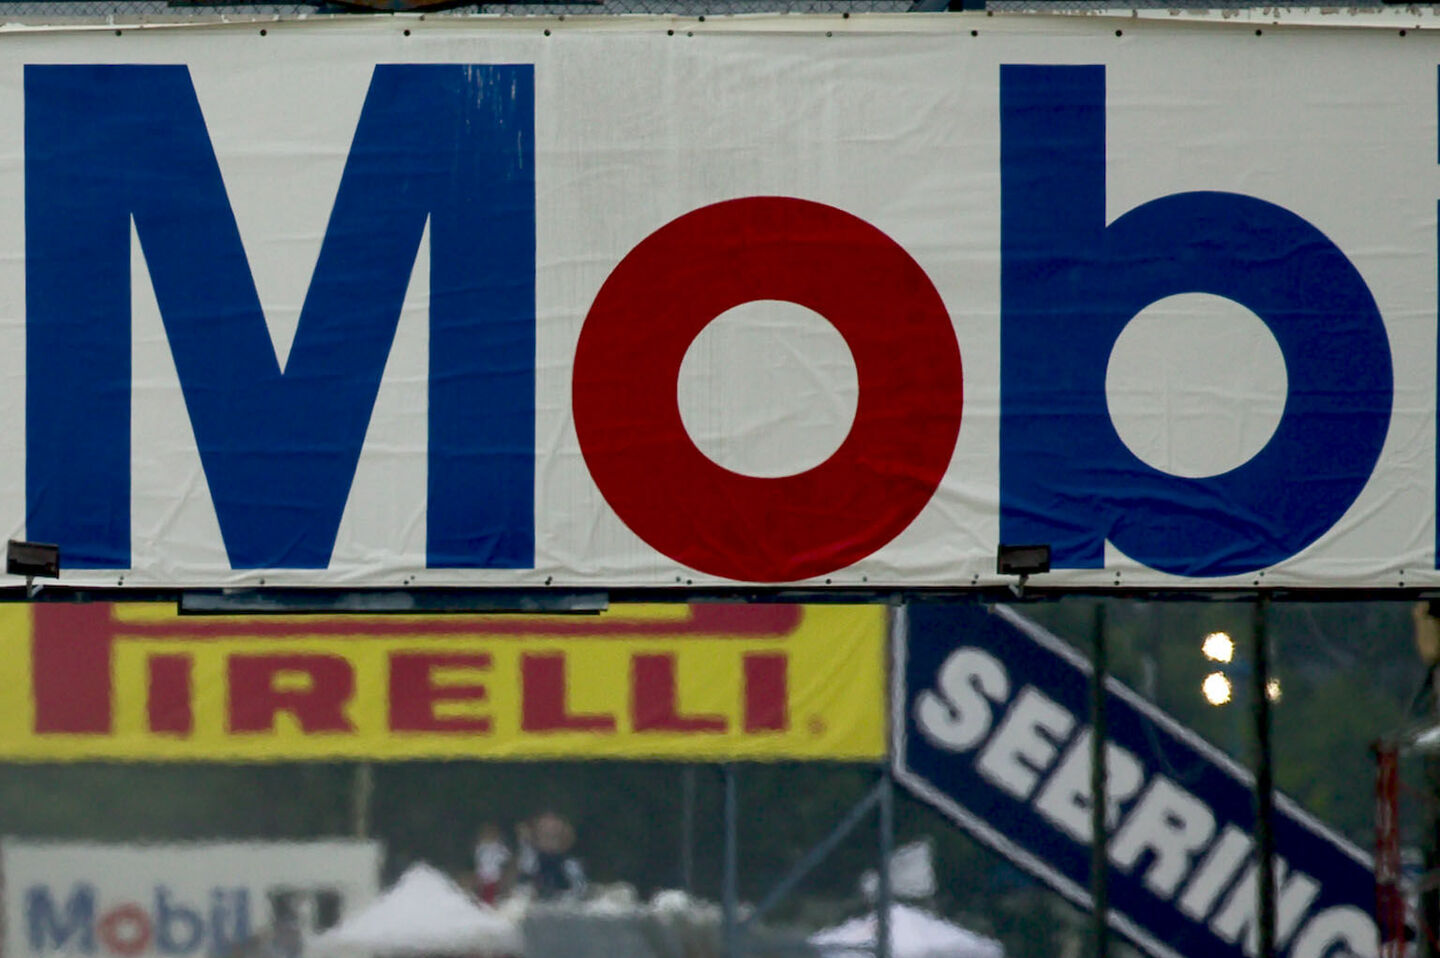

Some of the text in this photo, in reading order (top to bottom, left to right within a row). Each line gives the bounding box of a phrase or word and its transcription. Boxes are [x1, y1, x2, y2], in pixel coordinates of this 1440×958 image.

[24, 63, 1440, 584] Mob
[32, 602, 803, 735] PIRELLI
[24, 881, 252, 958] Mobil
